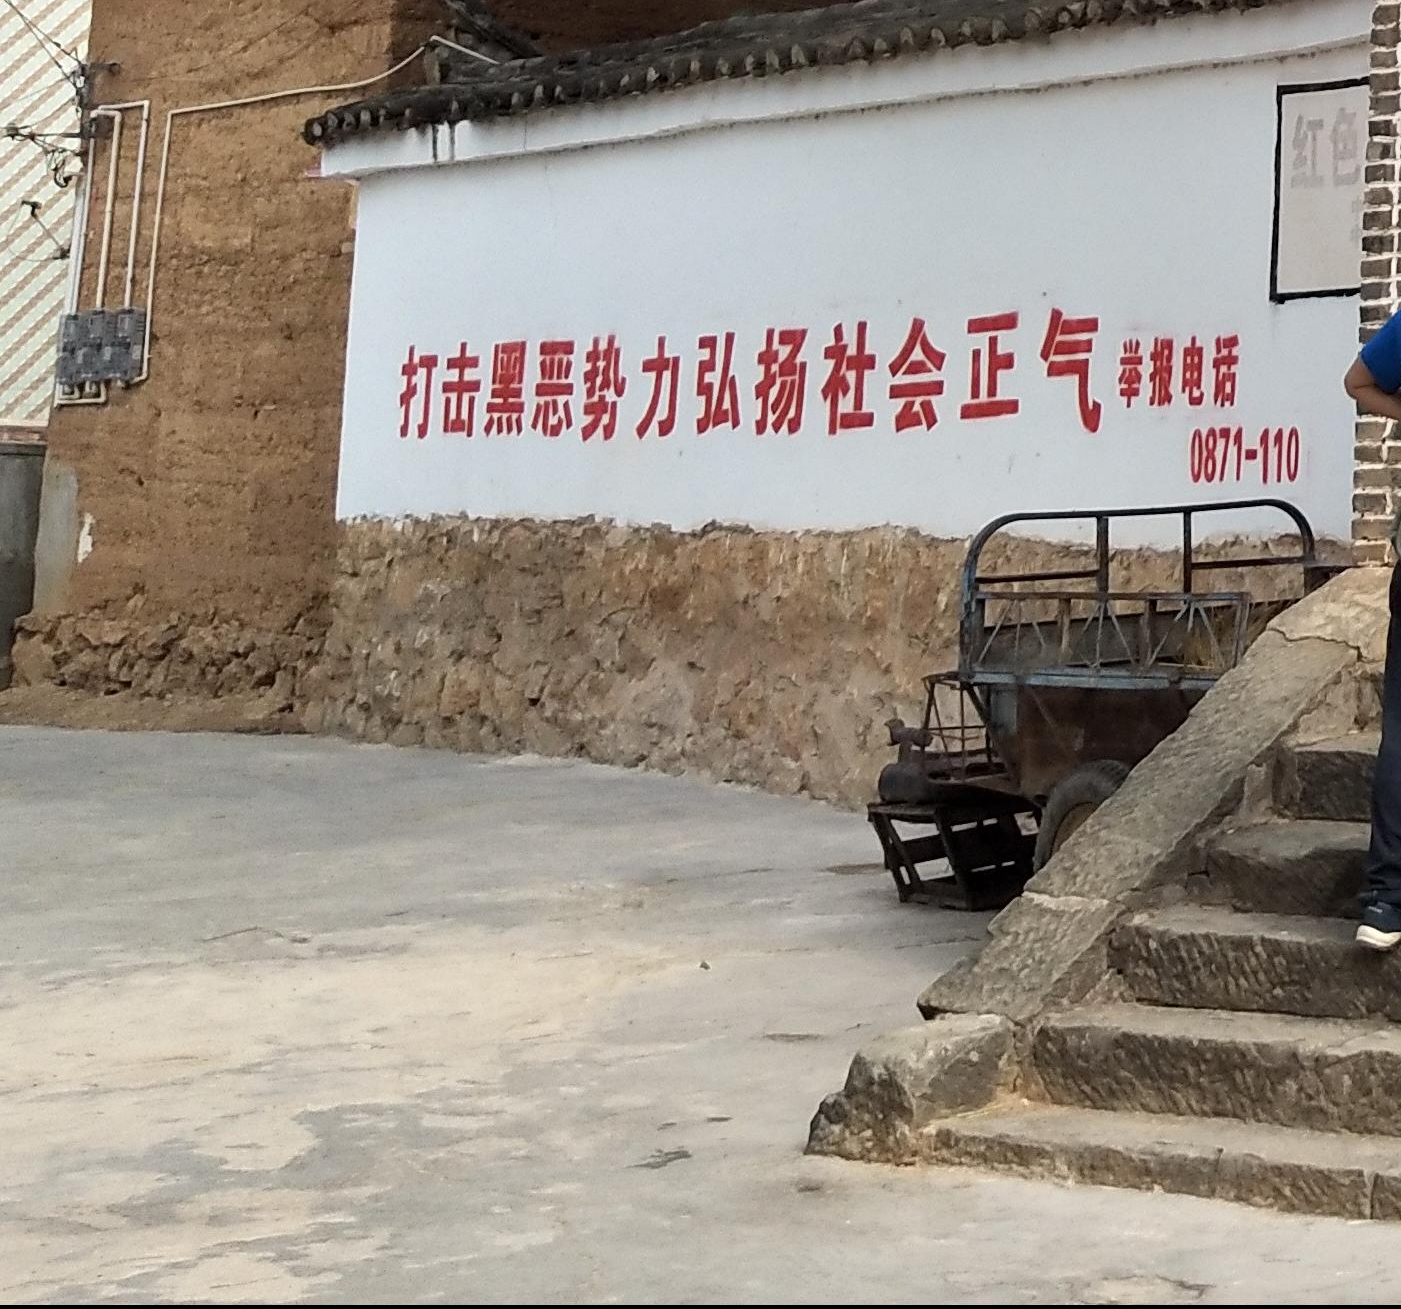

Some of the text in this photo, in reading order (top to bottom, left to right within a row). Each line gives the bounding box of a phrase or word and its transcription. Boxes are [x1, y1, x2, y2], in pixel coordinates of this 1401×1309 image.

[400, 309, 1240, 442] 打击黑恶势力弘扬社会正气 举报电话
[1190, 427, 1300, 485] 0871-110
